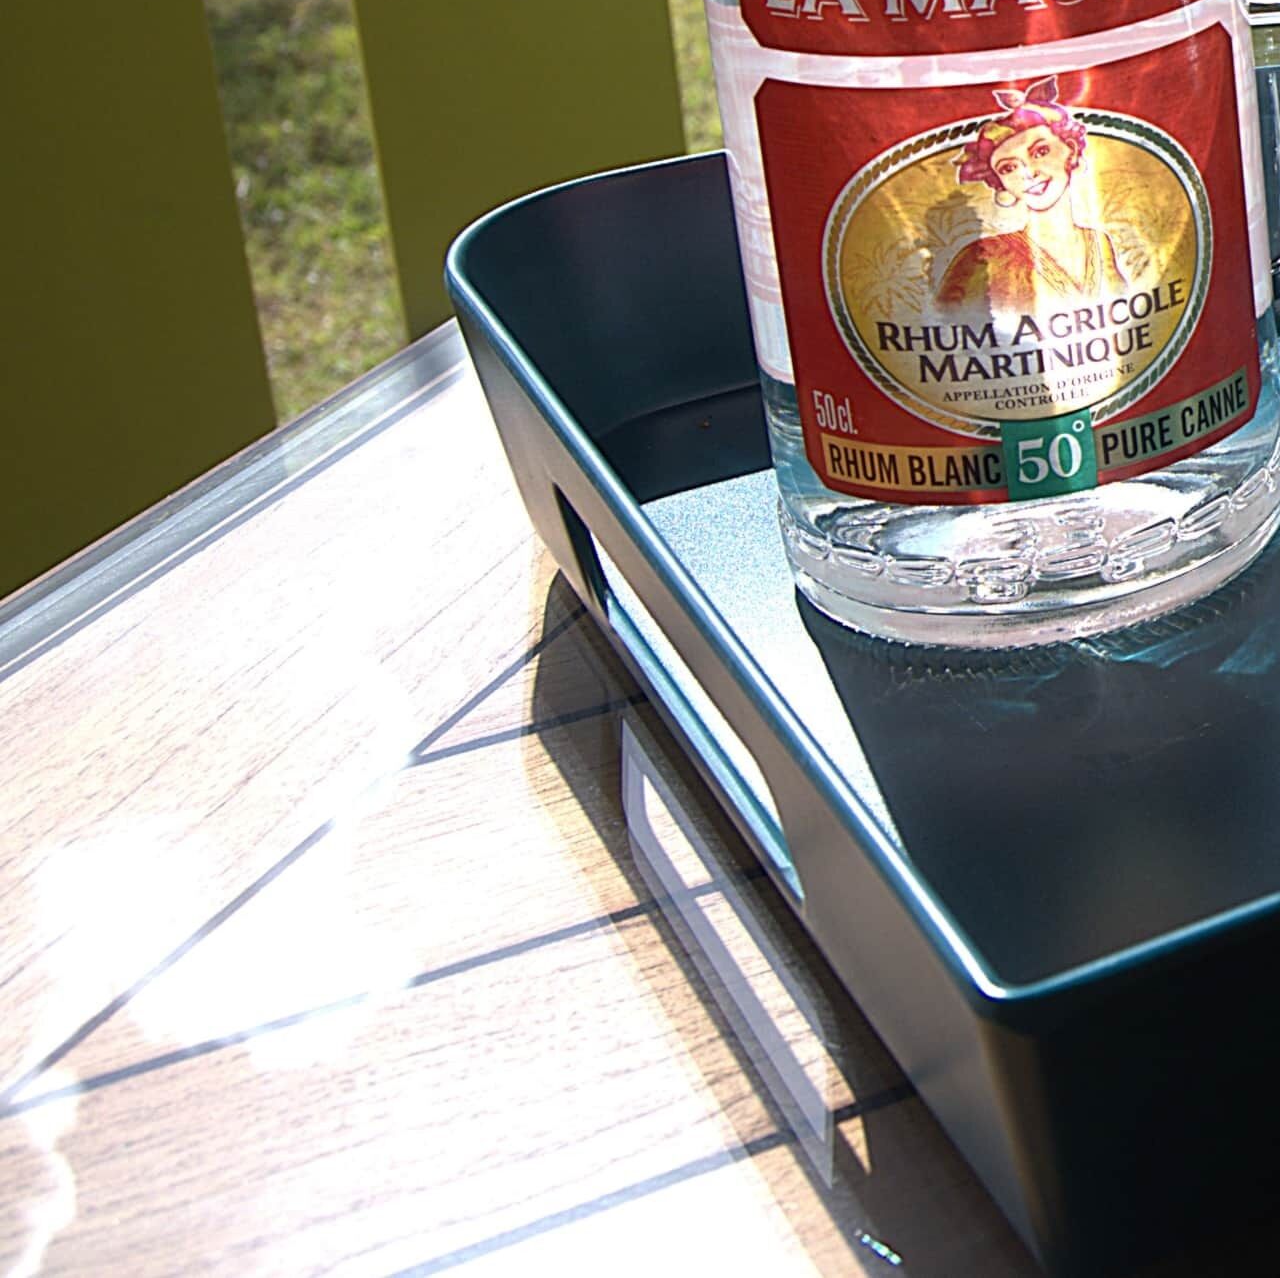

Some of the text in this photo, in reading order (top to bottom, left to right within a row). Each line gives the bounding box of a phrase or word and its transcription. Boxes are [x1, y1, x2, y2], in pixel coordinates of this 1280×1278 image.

[876, 278, 1185, 353] RHUM AGRICOLE
[919, 323, 1153, 384] MARTINIQUE
[943, 382, 1050, 403] APPELLATION
[1102, 375, 1247, 466] PURE CANNE
[828, 442, 1001, 487] RHUM BLANC
[1017, 419, 1086, 485] 50°
